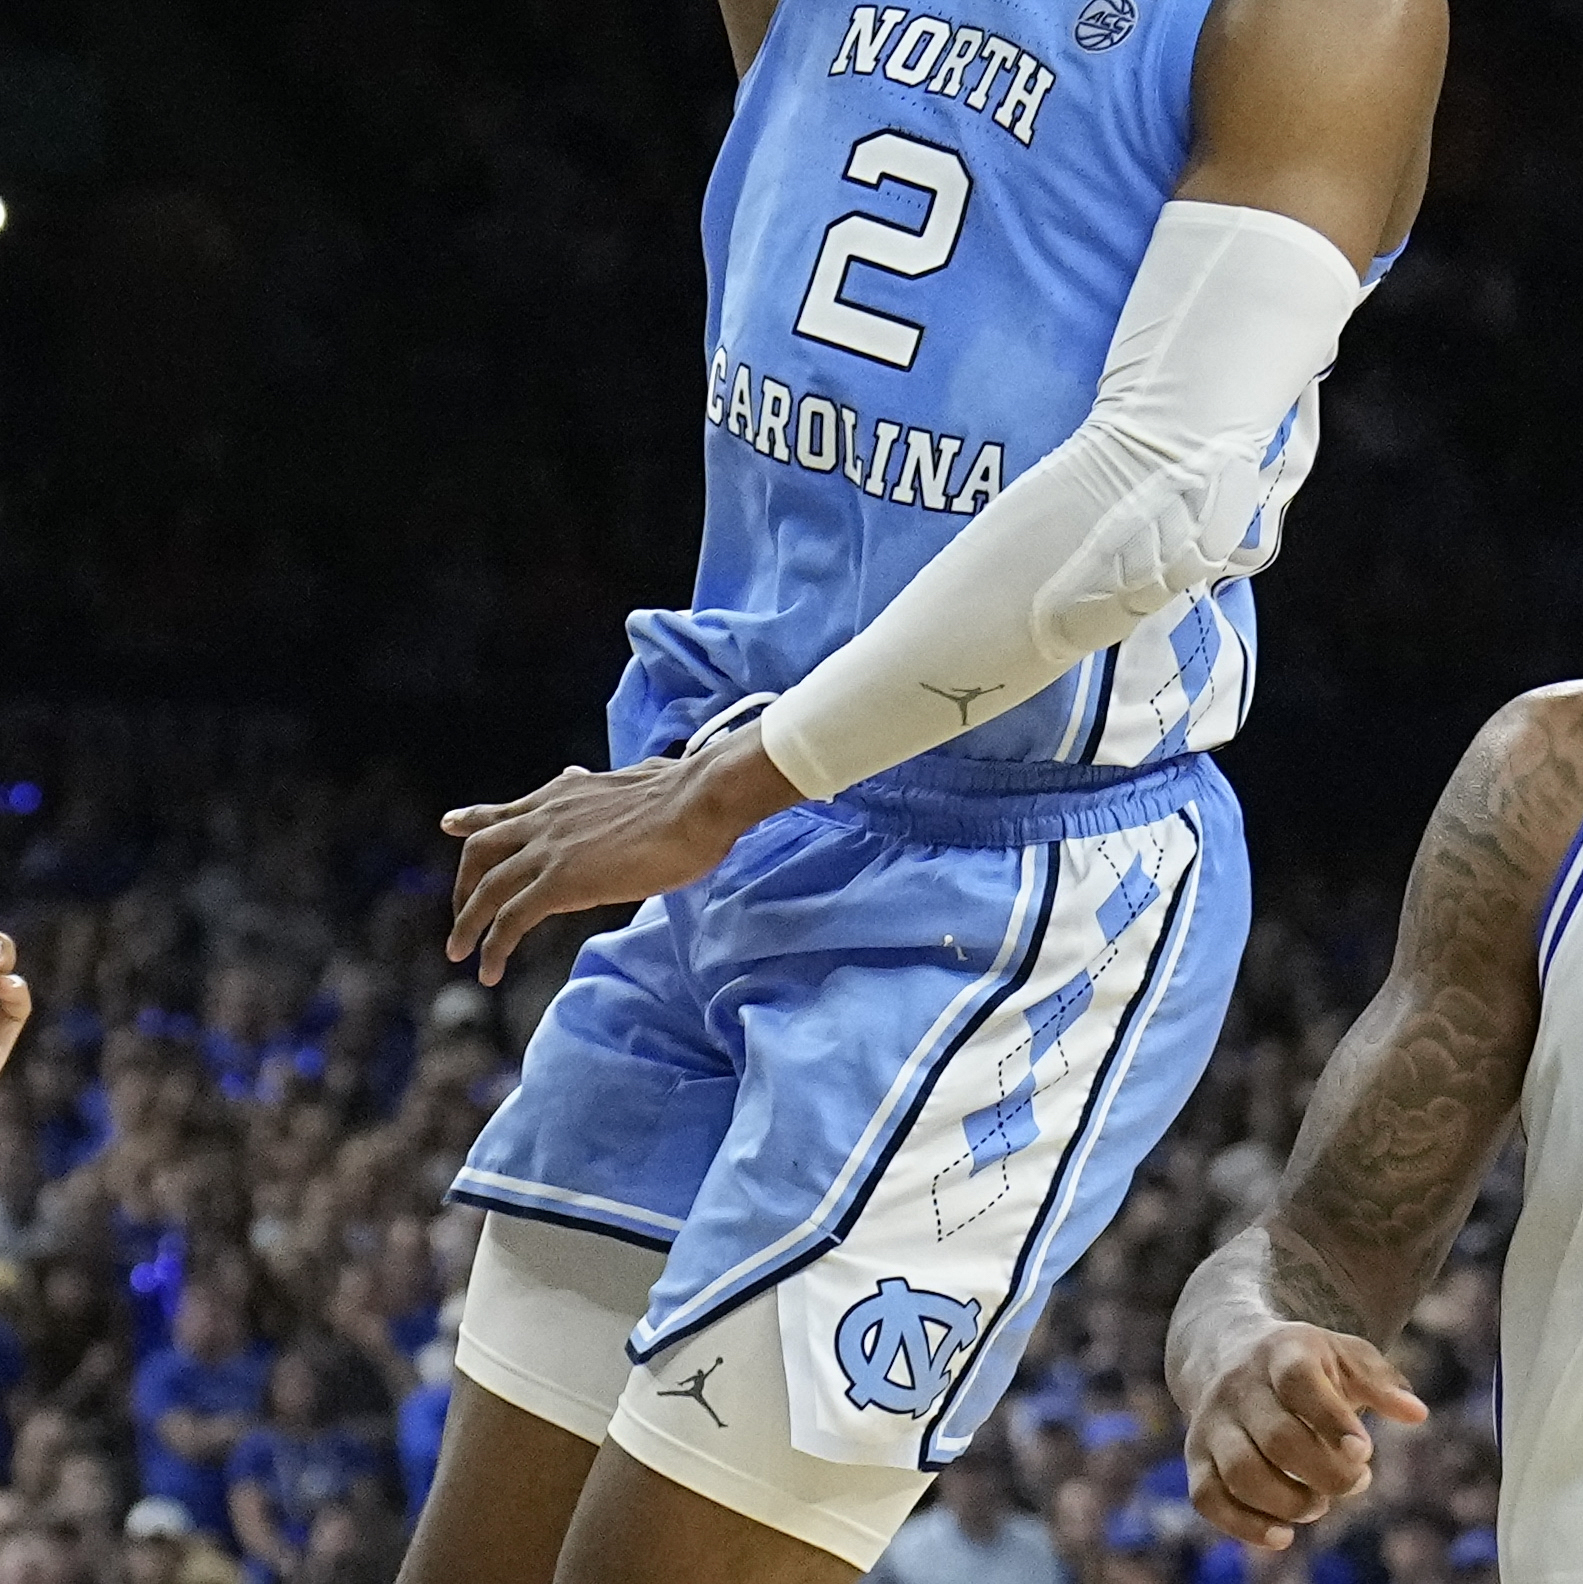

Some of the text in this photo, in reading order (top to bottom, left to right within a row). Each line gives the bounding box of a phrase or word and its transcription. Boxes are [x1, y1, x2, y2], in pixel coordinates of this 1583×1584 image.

[828, 5, 1056, 146] NORTH
[1084, 10, 1132, 35] ACC
[792, 127, 974, 373] 2
[706, 344, 1005, 517] CAROLINA
